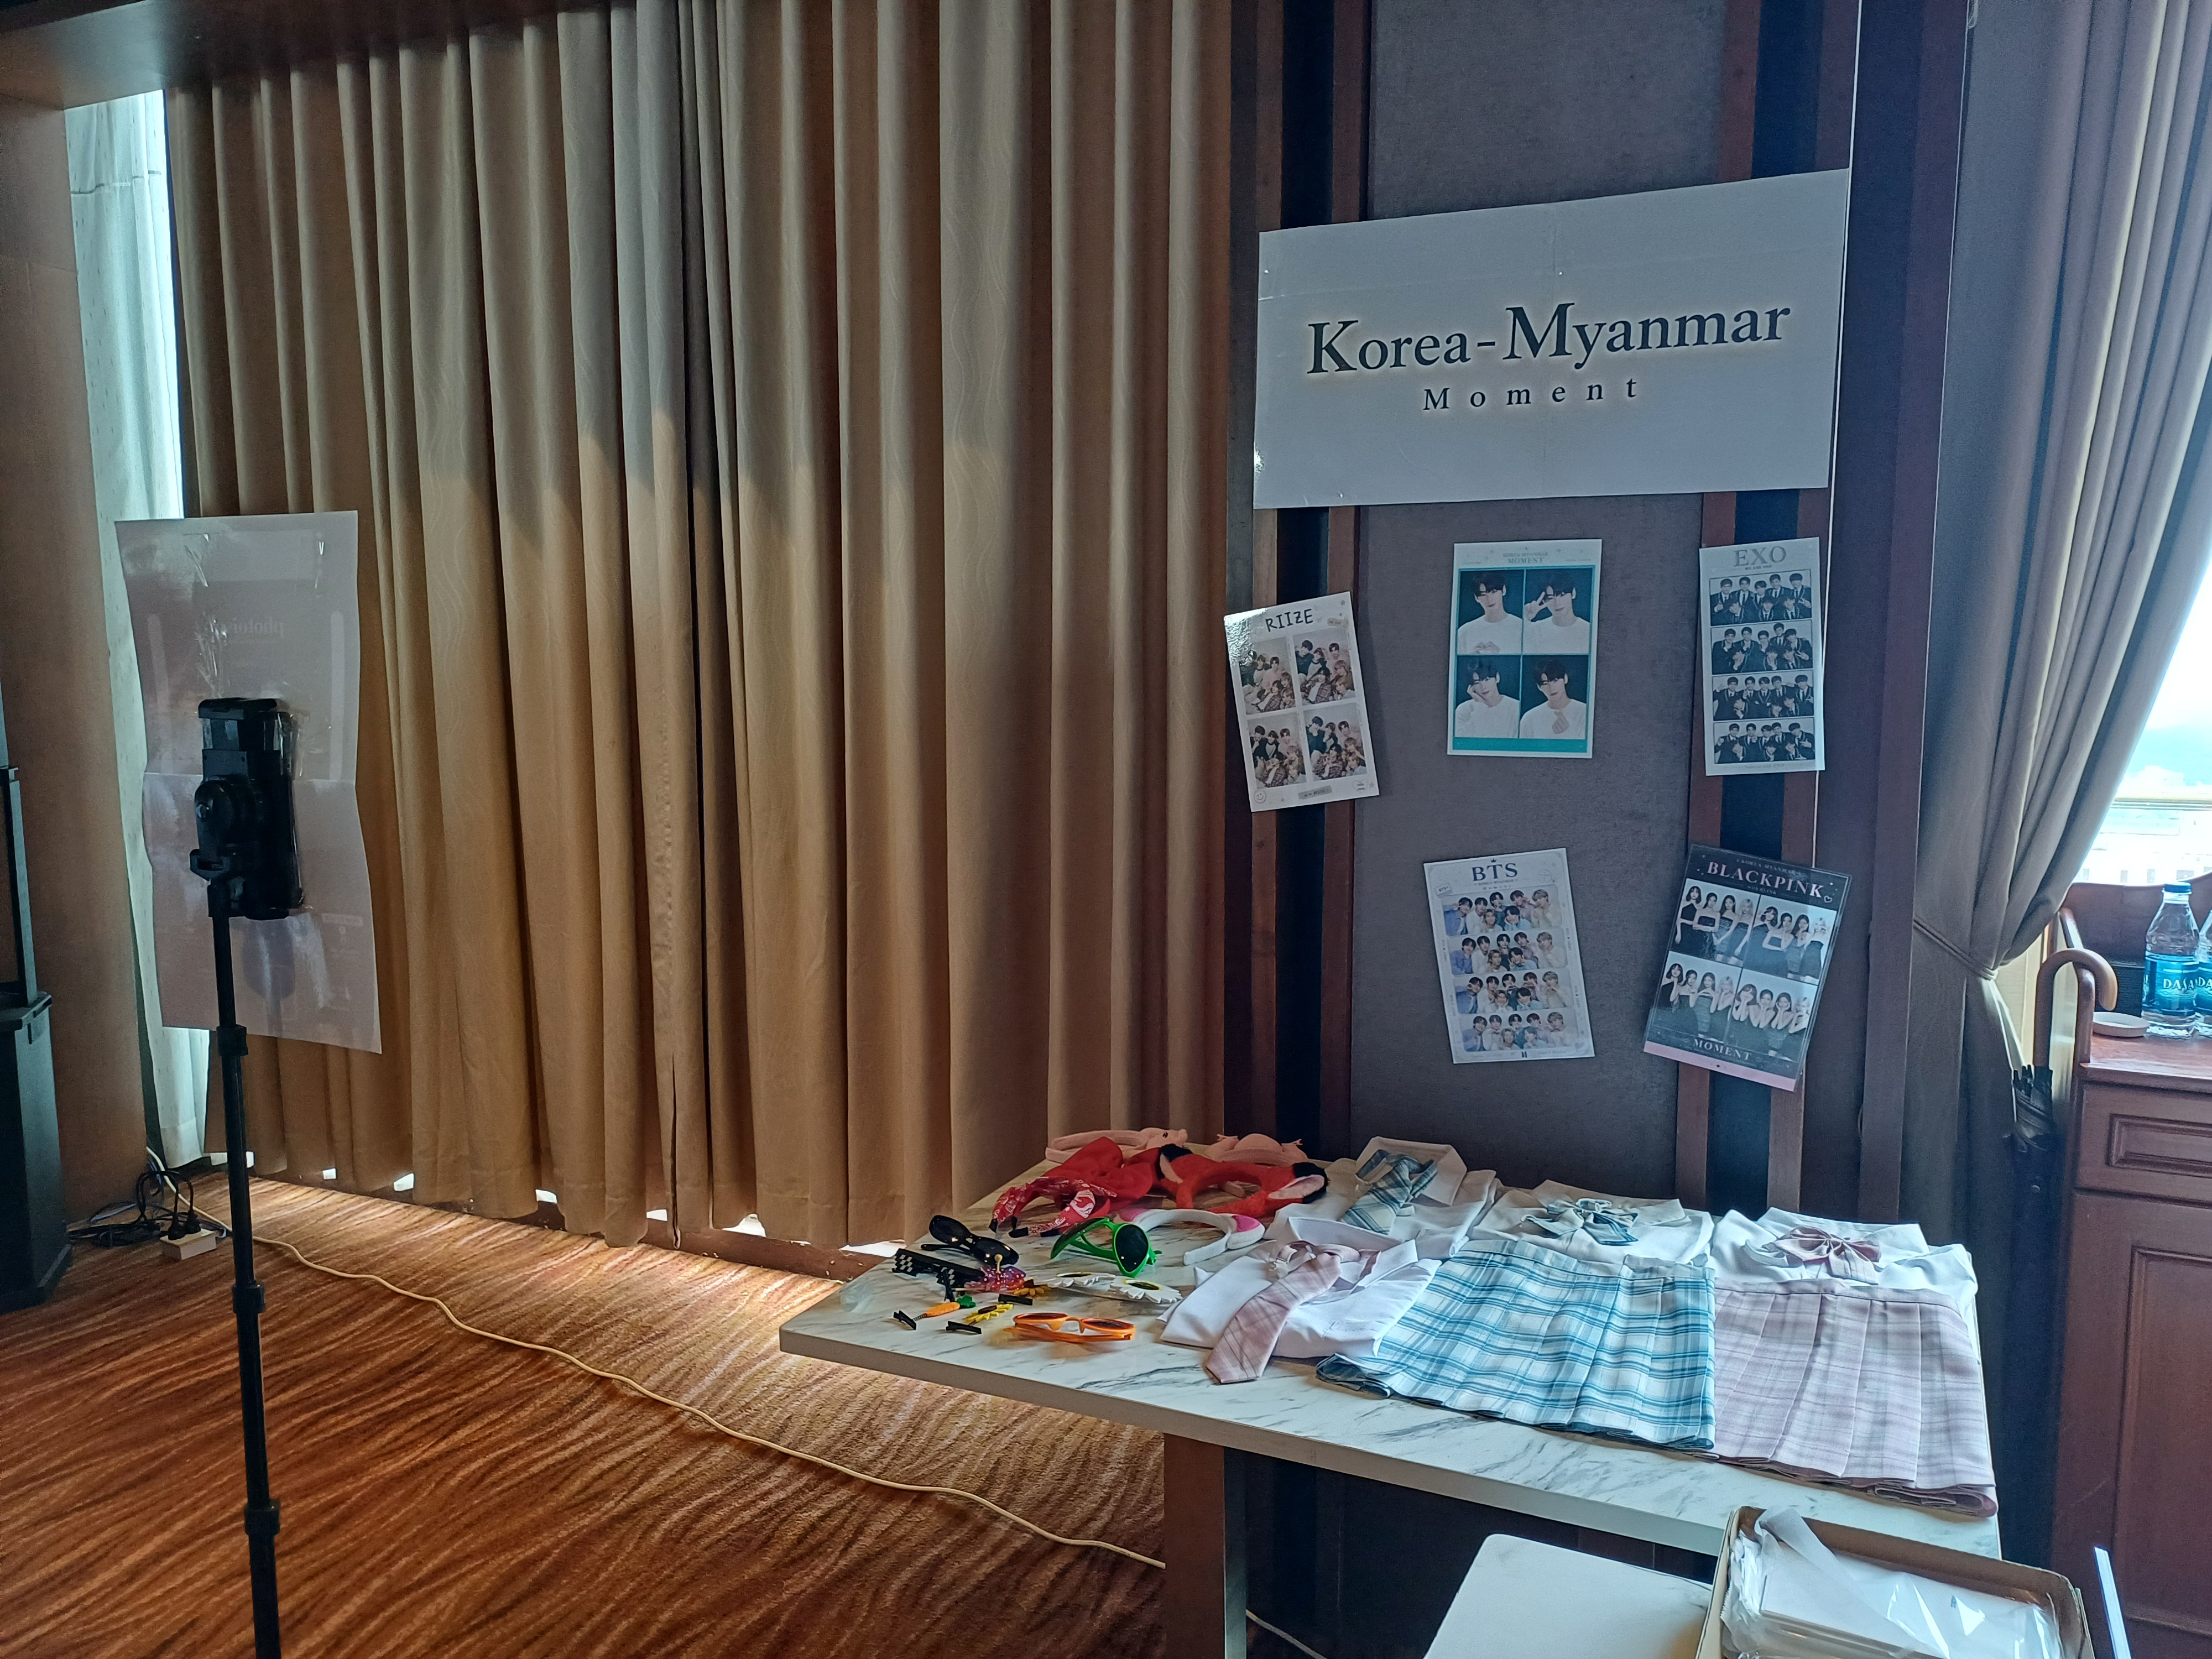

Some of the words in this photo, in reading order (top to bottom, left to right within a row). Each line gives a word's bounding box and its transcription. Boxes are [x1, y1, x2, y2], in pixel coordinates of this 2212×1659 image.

[1306, 302, 1791, 374] Korea-Myanmar
[1422, 378, 1637, 410] Moment
[1733, 545, 1787, 567] EXO
[1265, 608, 1314, 632] RIIZE
[1472, 862, 1519, 881] BTS
[1707, 861, 1824, 898] BLACKPINK
[1693, 1038, 1752, 1061] MOMENT
